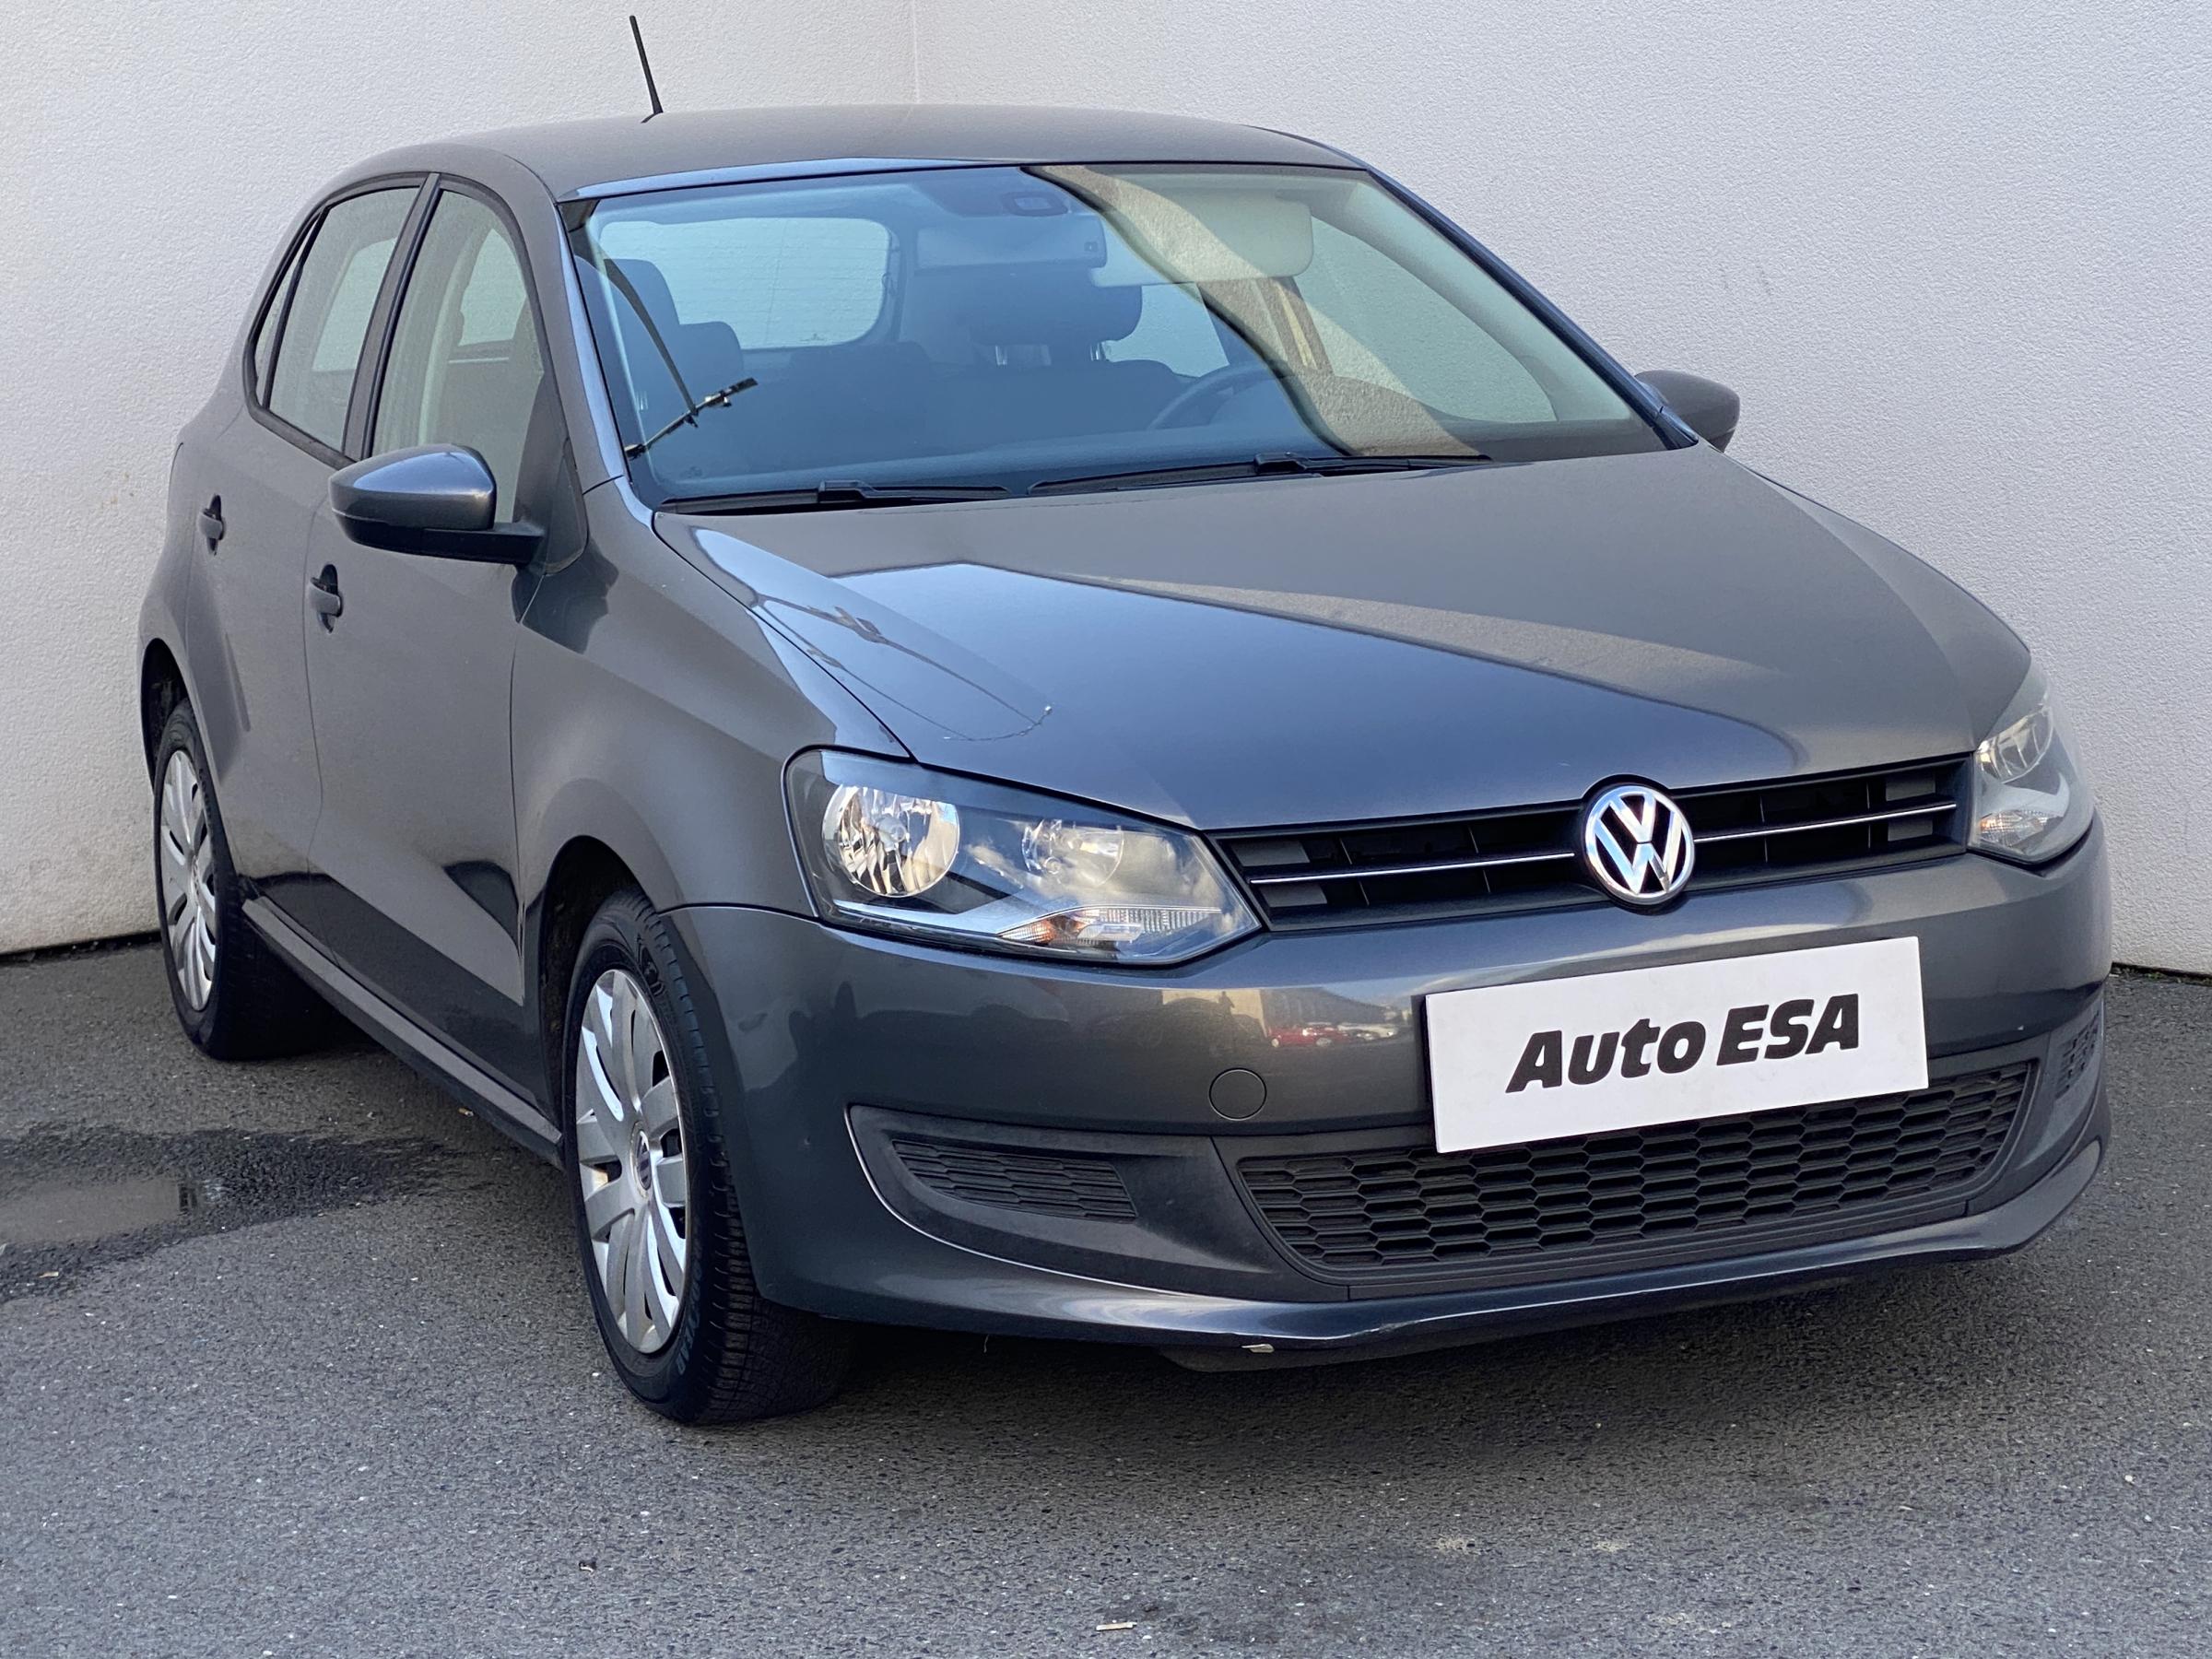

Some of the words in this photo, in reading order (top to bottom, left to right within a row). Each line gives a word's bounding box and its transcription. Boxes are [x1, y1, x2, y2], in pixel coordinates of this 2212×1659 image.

[1585, 785, 1695, 904] VW
[1505, 1018, 1706, 1094] Auto
[1716, 993, 1859, 1066] ESA
